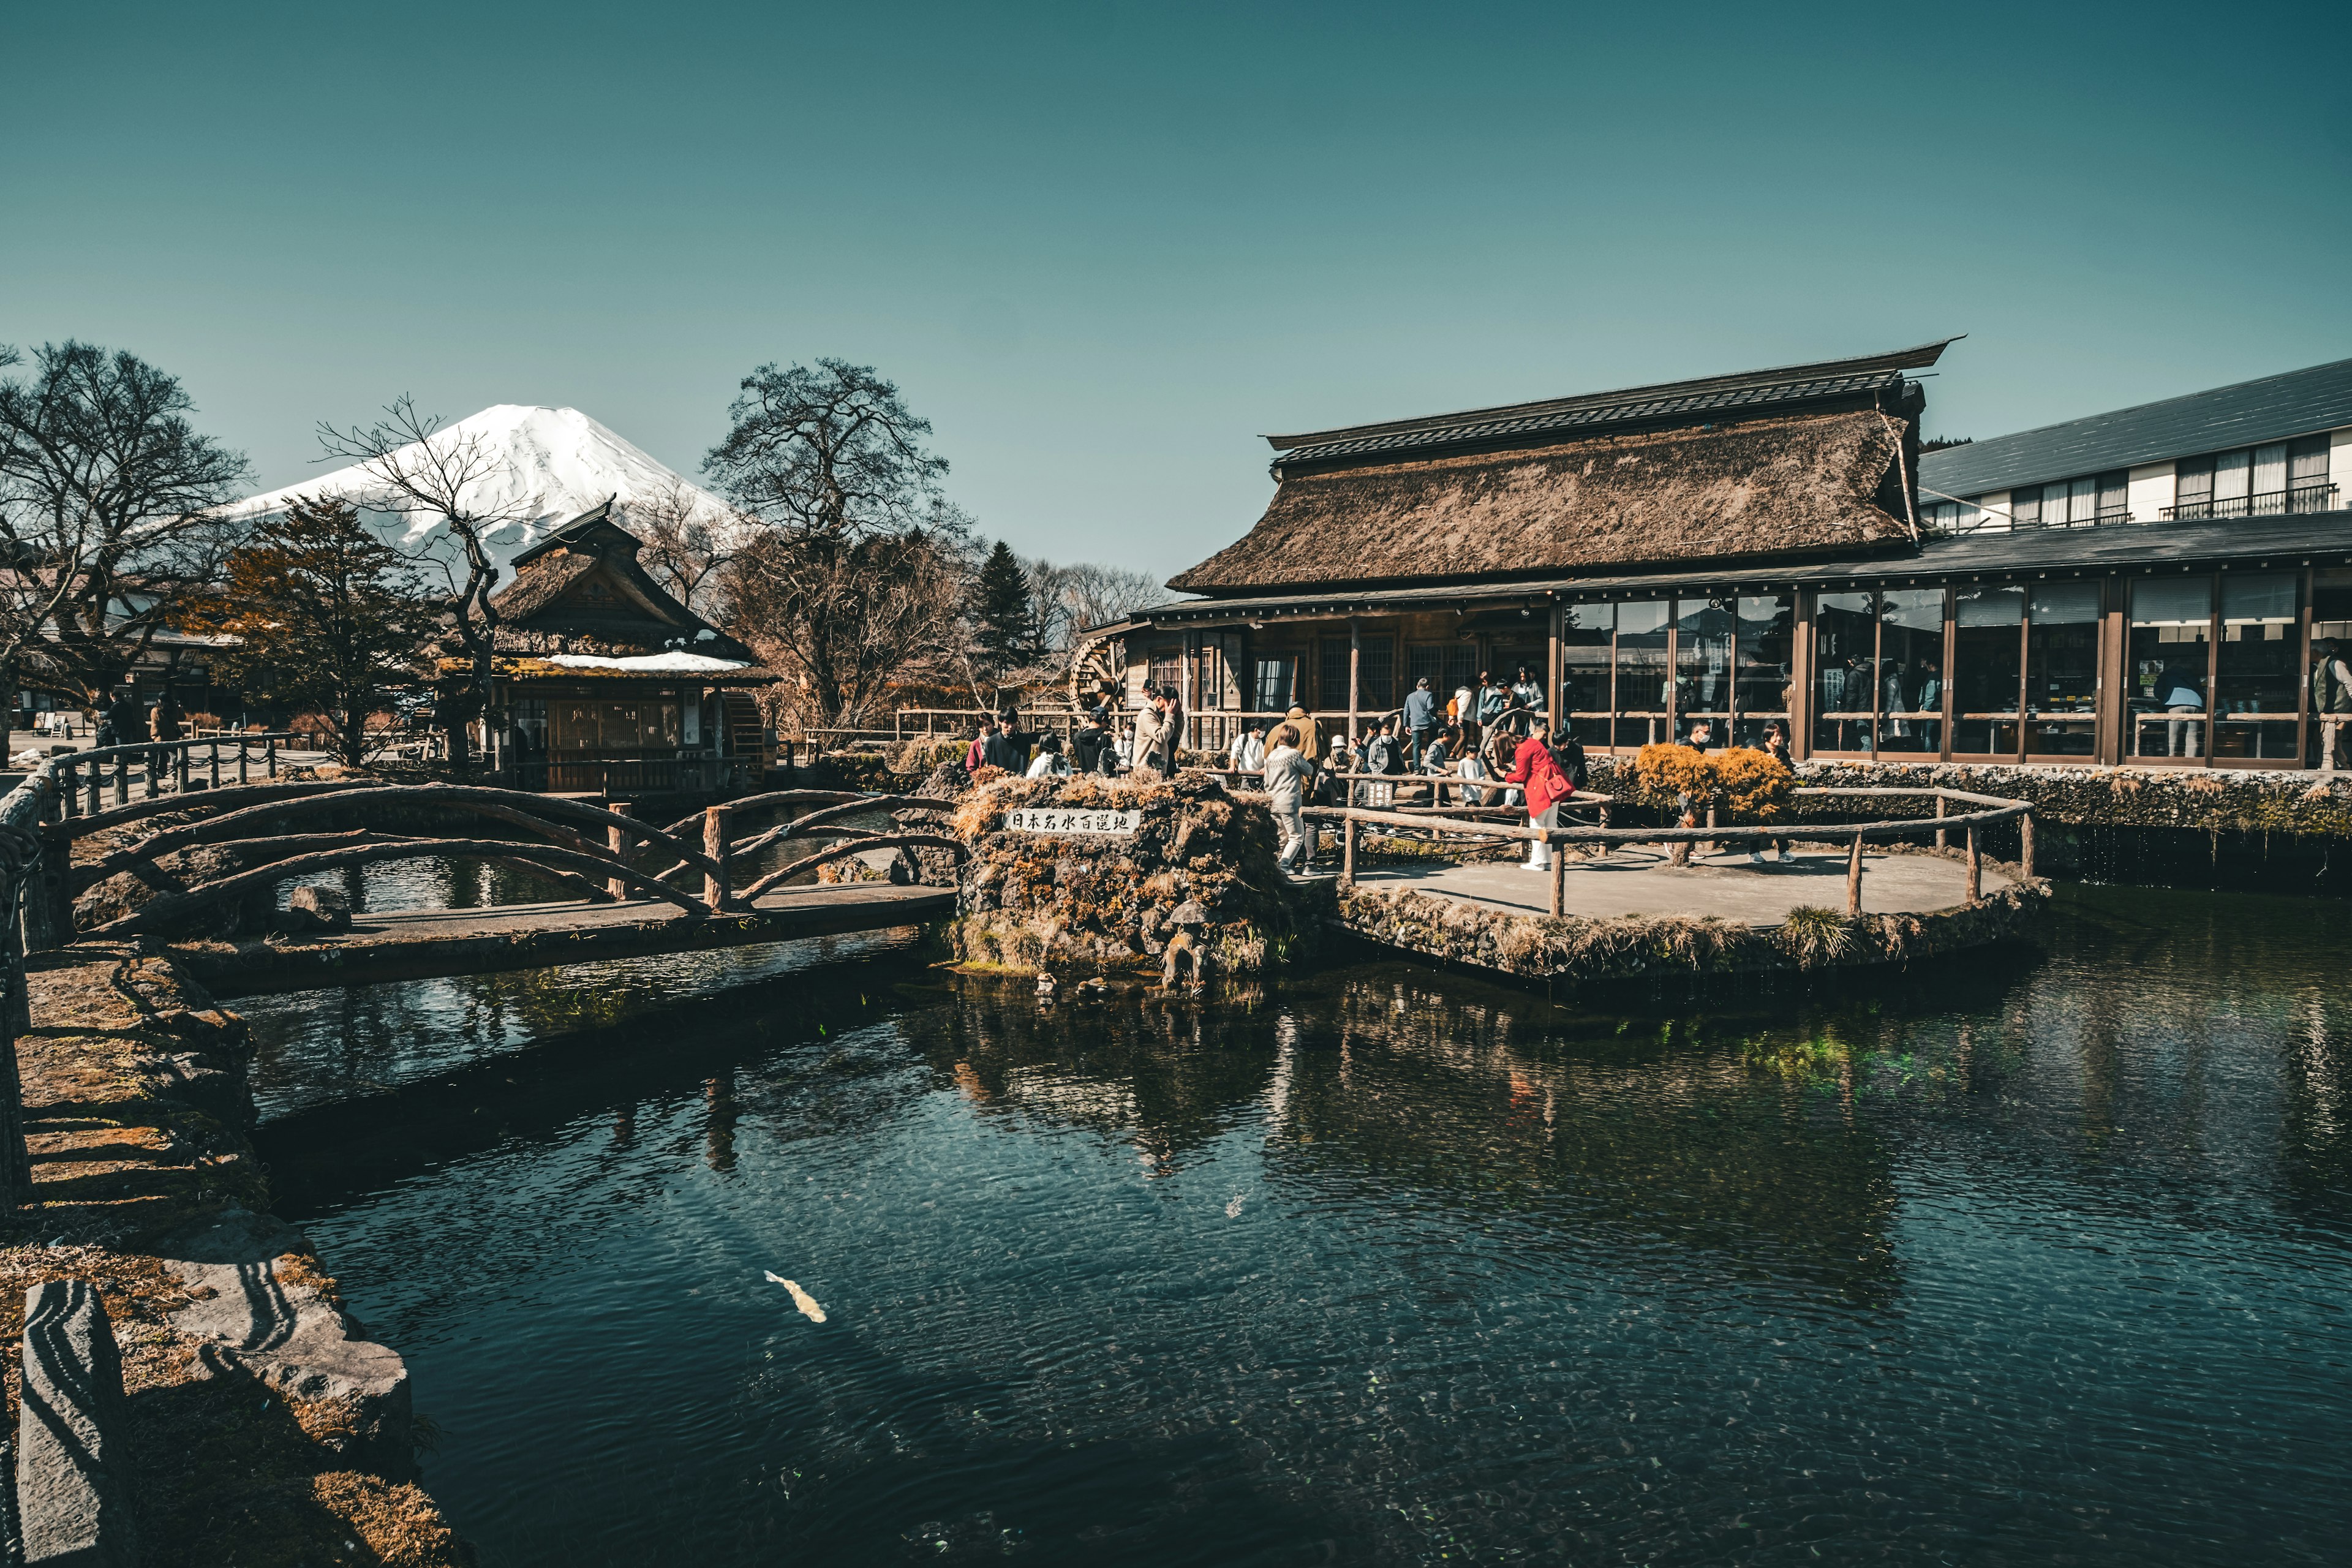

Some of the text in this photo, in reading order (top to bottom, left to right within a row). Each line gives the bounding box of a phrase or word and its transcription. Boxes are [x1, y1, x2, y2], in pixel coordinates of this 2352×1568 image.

[1012, 813, 1129, 831] 日本名水百選地
